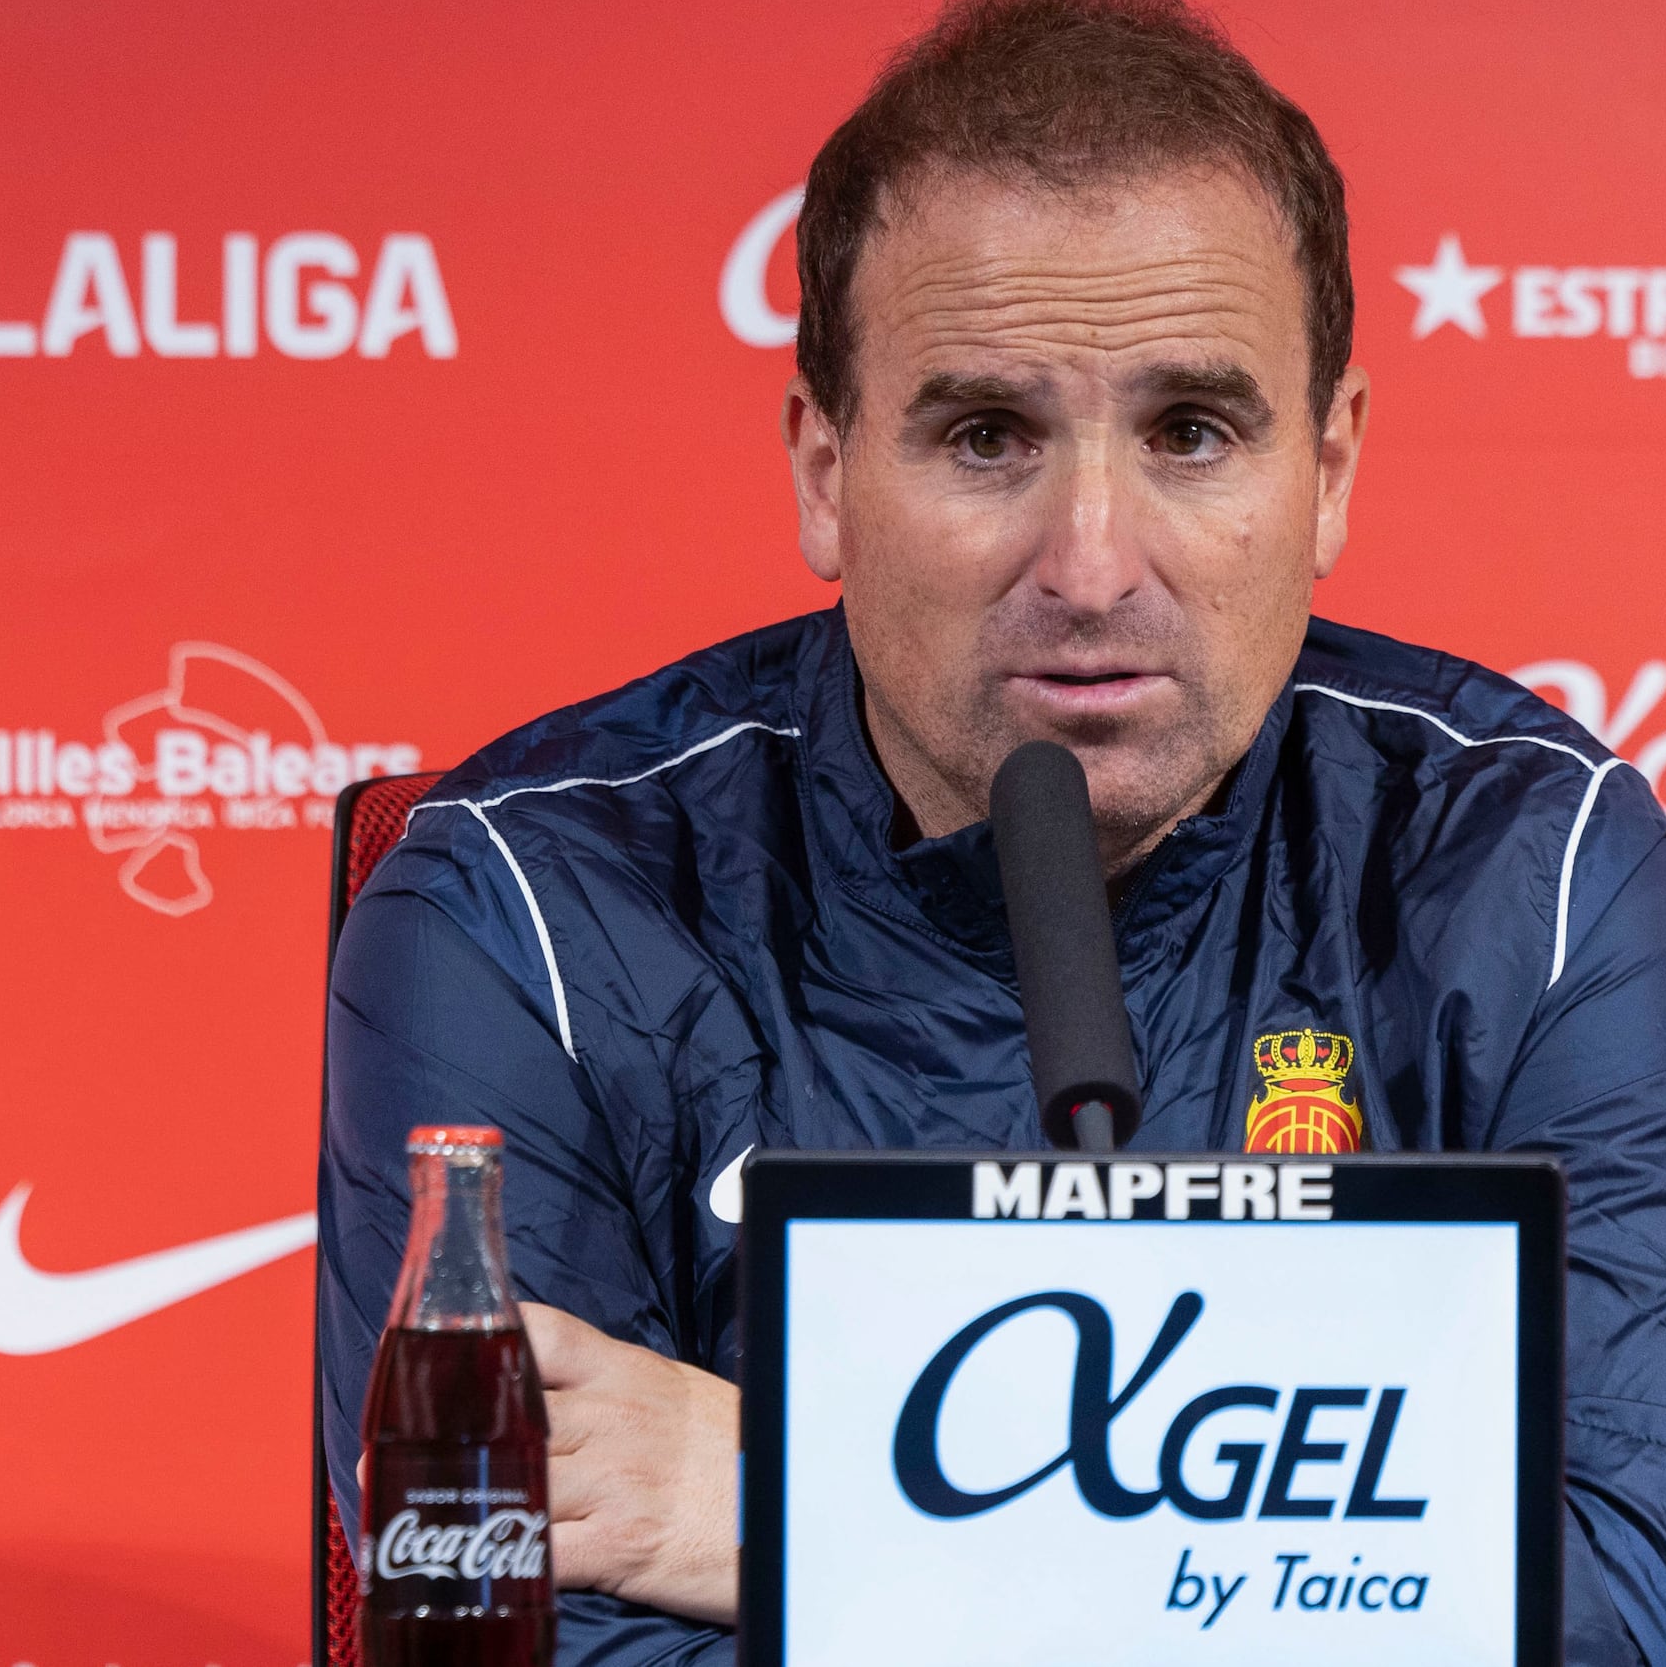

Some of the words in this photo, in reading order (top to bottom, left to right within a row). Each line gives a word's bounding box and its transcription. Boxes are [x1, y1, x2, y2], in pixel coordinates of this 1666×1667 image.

[973, 1163, 1333, 1219] MAPFRE
[376, 1508, 549, 1580] Coca-Cola
[1166, 1549, 1246, 1628] by
[1274, 1554, 1429, 1611] Taica
